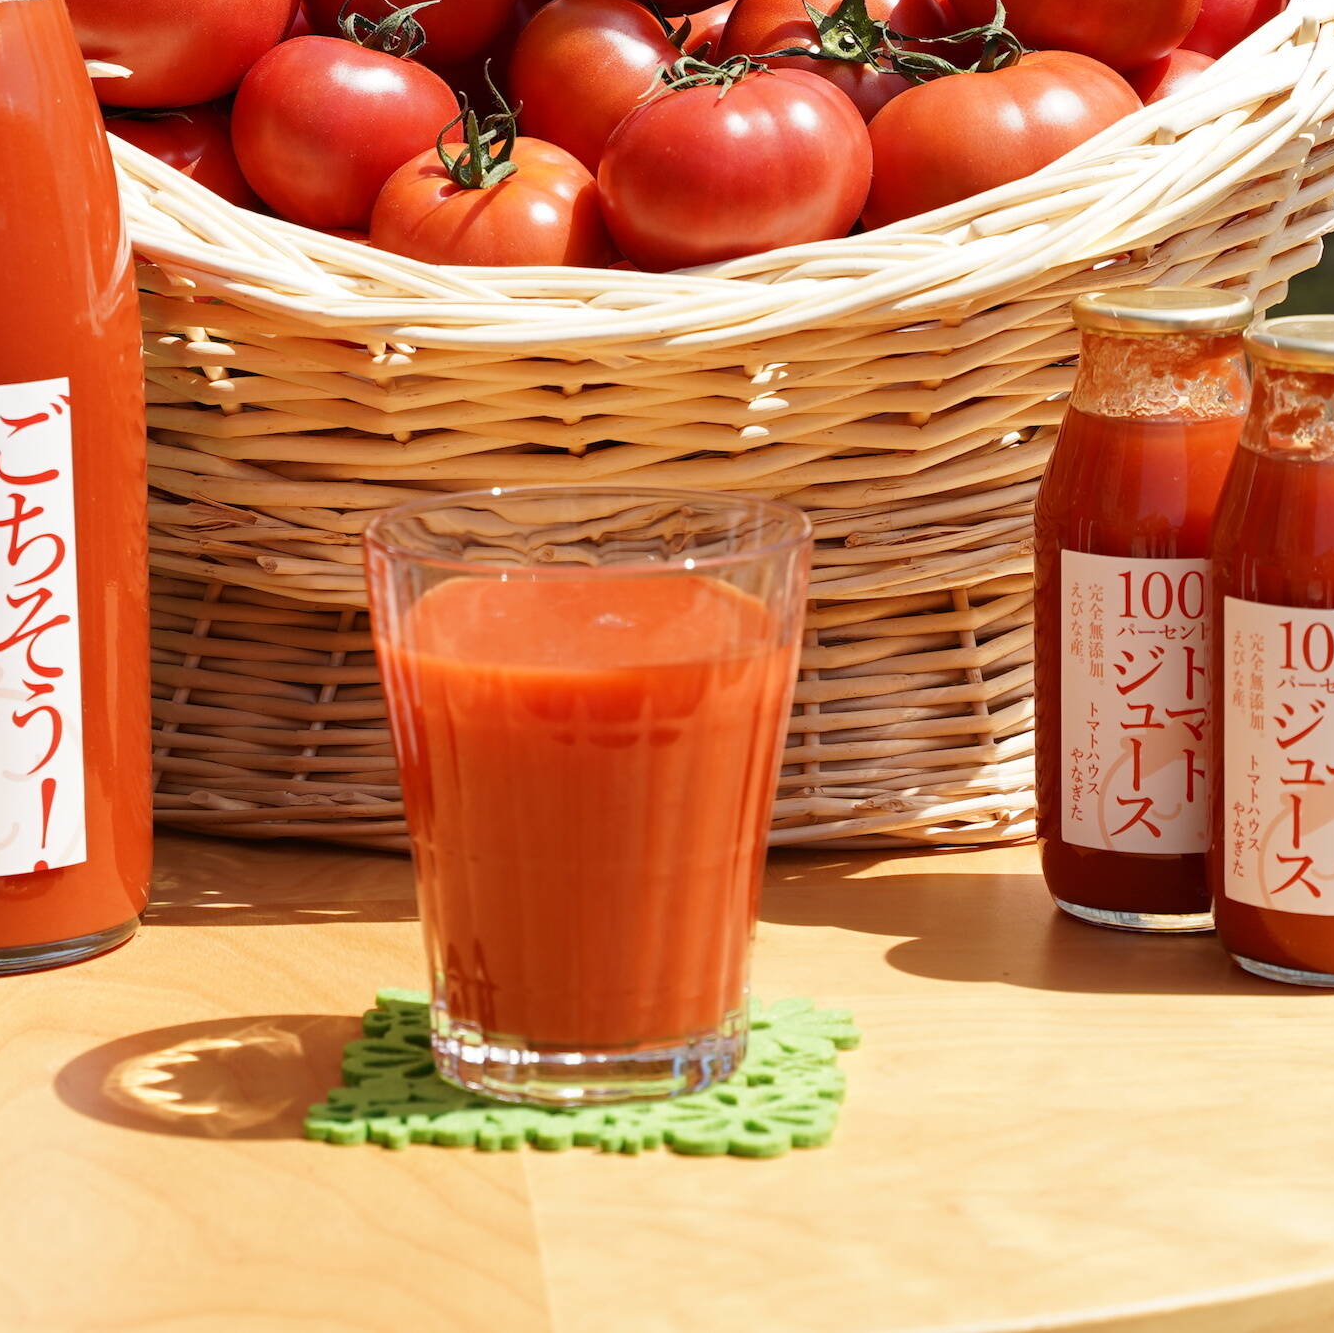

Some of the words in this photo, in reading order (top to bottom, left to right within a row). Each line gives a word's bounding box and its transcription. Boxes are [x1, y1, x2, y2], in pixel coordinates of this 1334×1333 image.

[1071, 582, 1085, 664] えびな産。
[1088, 583, 1105, 686] 完全無添加。
[1118, 571, 1205, 620] 100
[1232, 632, 1247, 715] えびな産。
[1249, 633, 1266, 739] 完全無添加。
[1071, 748, 1084, 822] やなぎた
[1086, 702, 1100, 796] トマトハウス
[1110, 645, 1165, 838] ジュース
[1232, 802, 1245, 878] やなぎた
[1247, 754, 1260, 851] トマトハウス
[1270, 699, 1326, 898] ジュース
